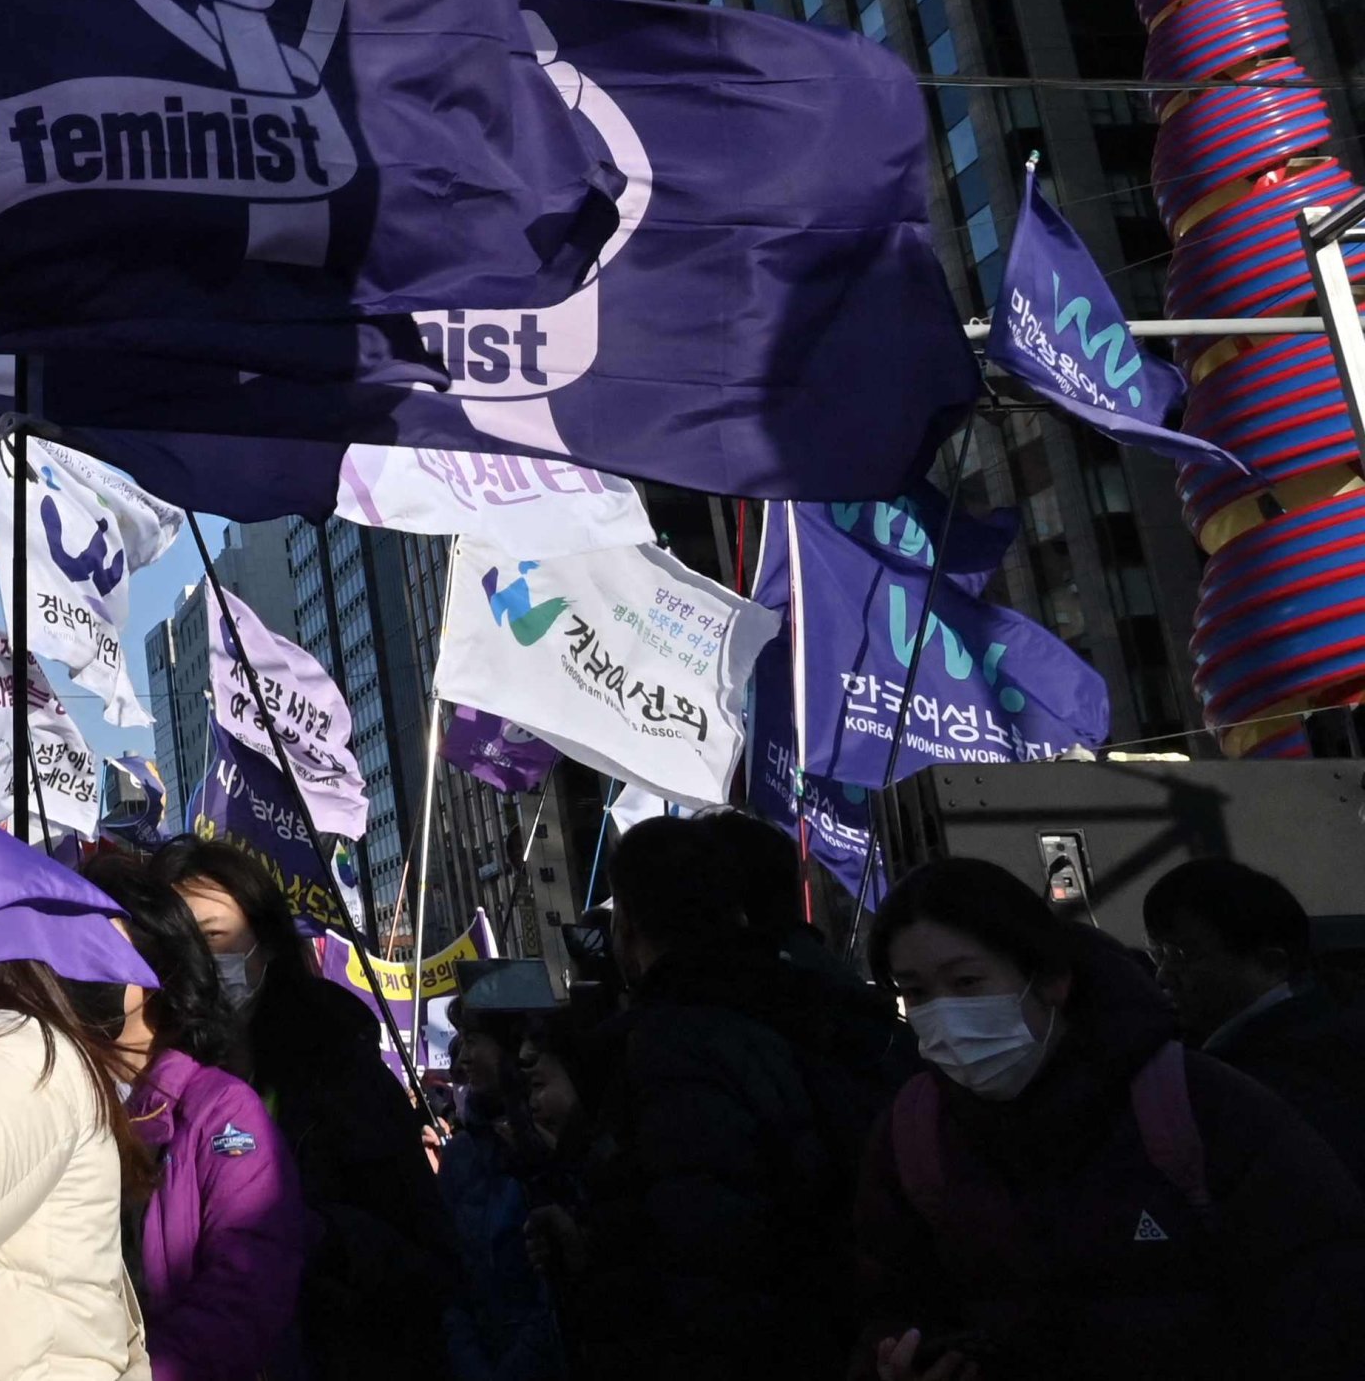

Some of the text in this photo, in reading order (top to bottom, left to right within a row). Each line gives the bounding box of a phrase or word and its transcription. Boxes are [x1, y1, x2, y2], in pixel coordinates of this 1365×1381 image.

[9, 96, 329, 187] feminist
[656, 588, 694, 621] 당당한
[687, 633, 718, 657] 여성
[678, 650, 709, 676] 여성
[845, 716, 903, 745] KOREA
[906, 733, 956, 760] WOMEN
